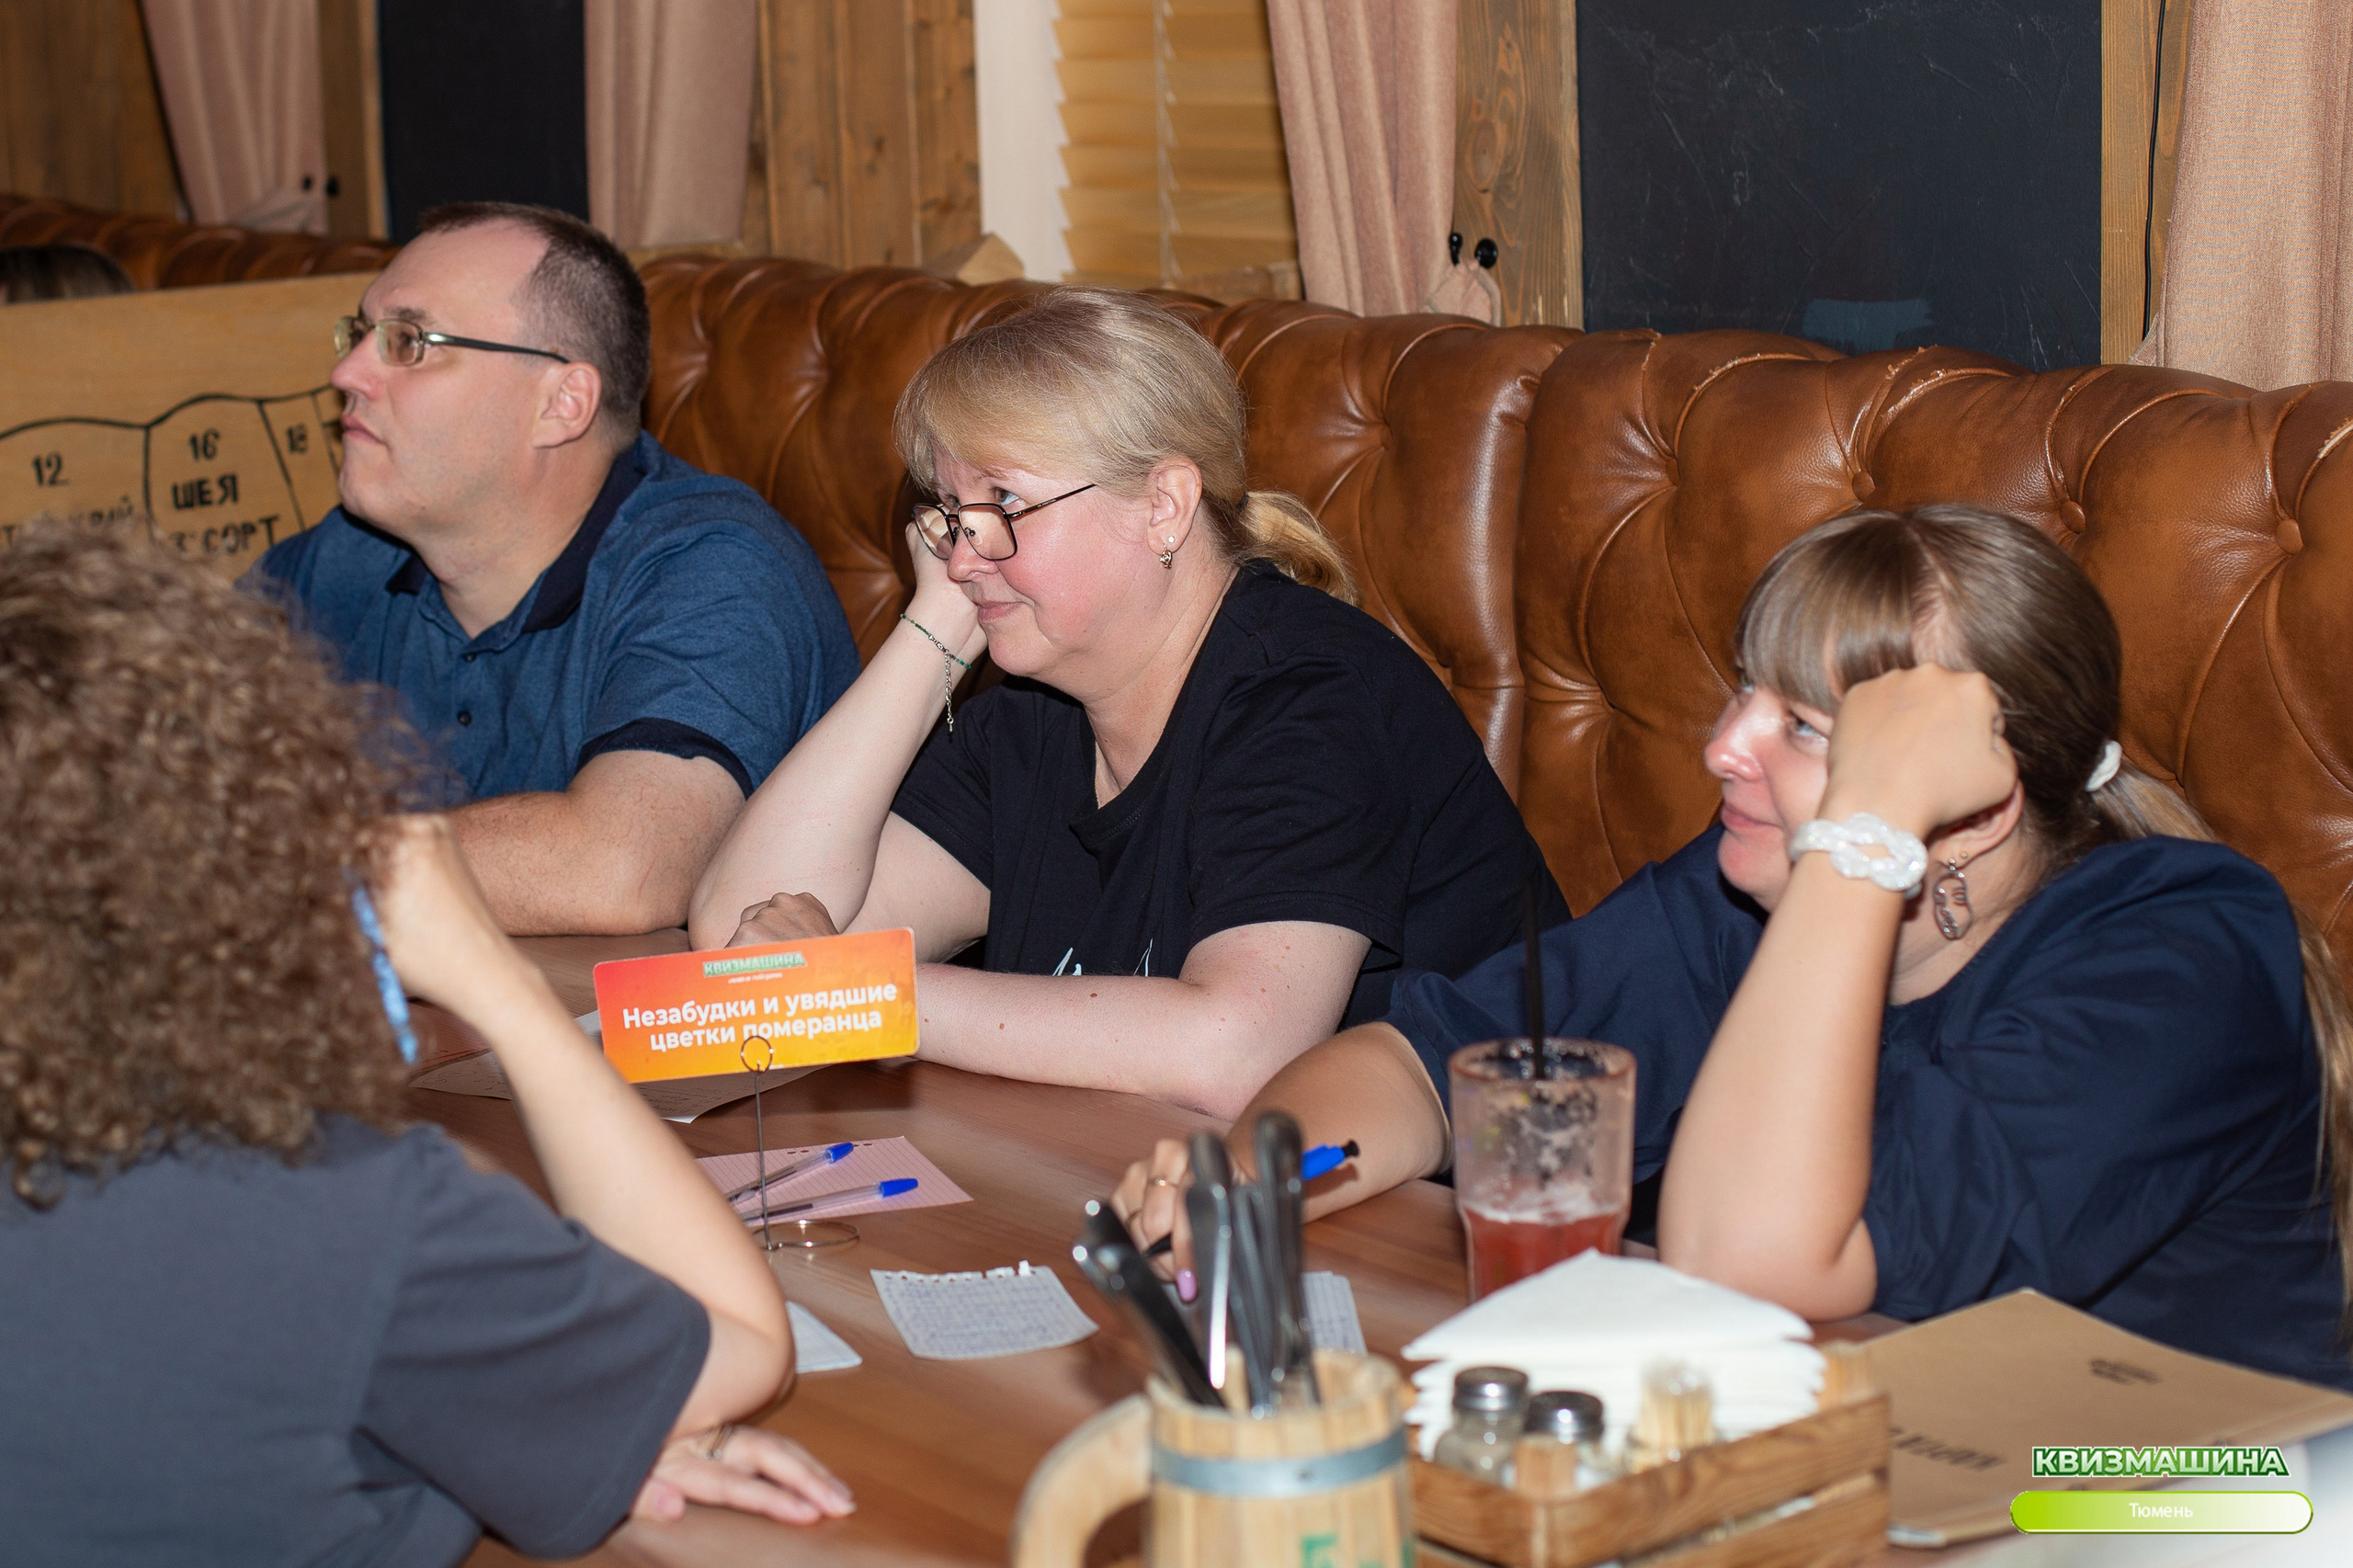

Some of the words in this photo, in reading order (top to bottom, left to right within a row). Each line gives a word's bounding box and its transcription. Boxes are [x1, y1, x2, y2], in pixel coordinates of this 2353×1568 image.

[189, 428, 220, 461] 16
[32, 451, 69, 487] 12
[172, 472, 239, 510] ШЕЯ
[622, 999, 756, 1029] Незабудки
[762, 995, 779, 1015] и
[784, 983, 898, 1016] увядшие
[649, 1026, 736, 1052] цветки
[743, 1010, 882, 1040] померанца
